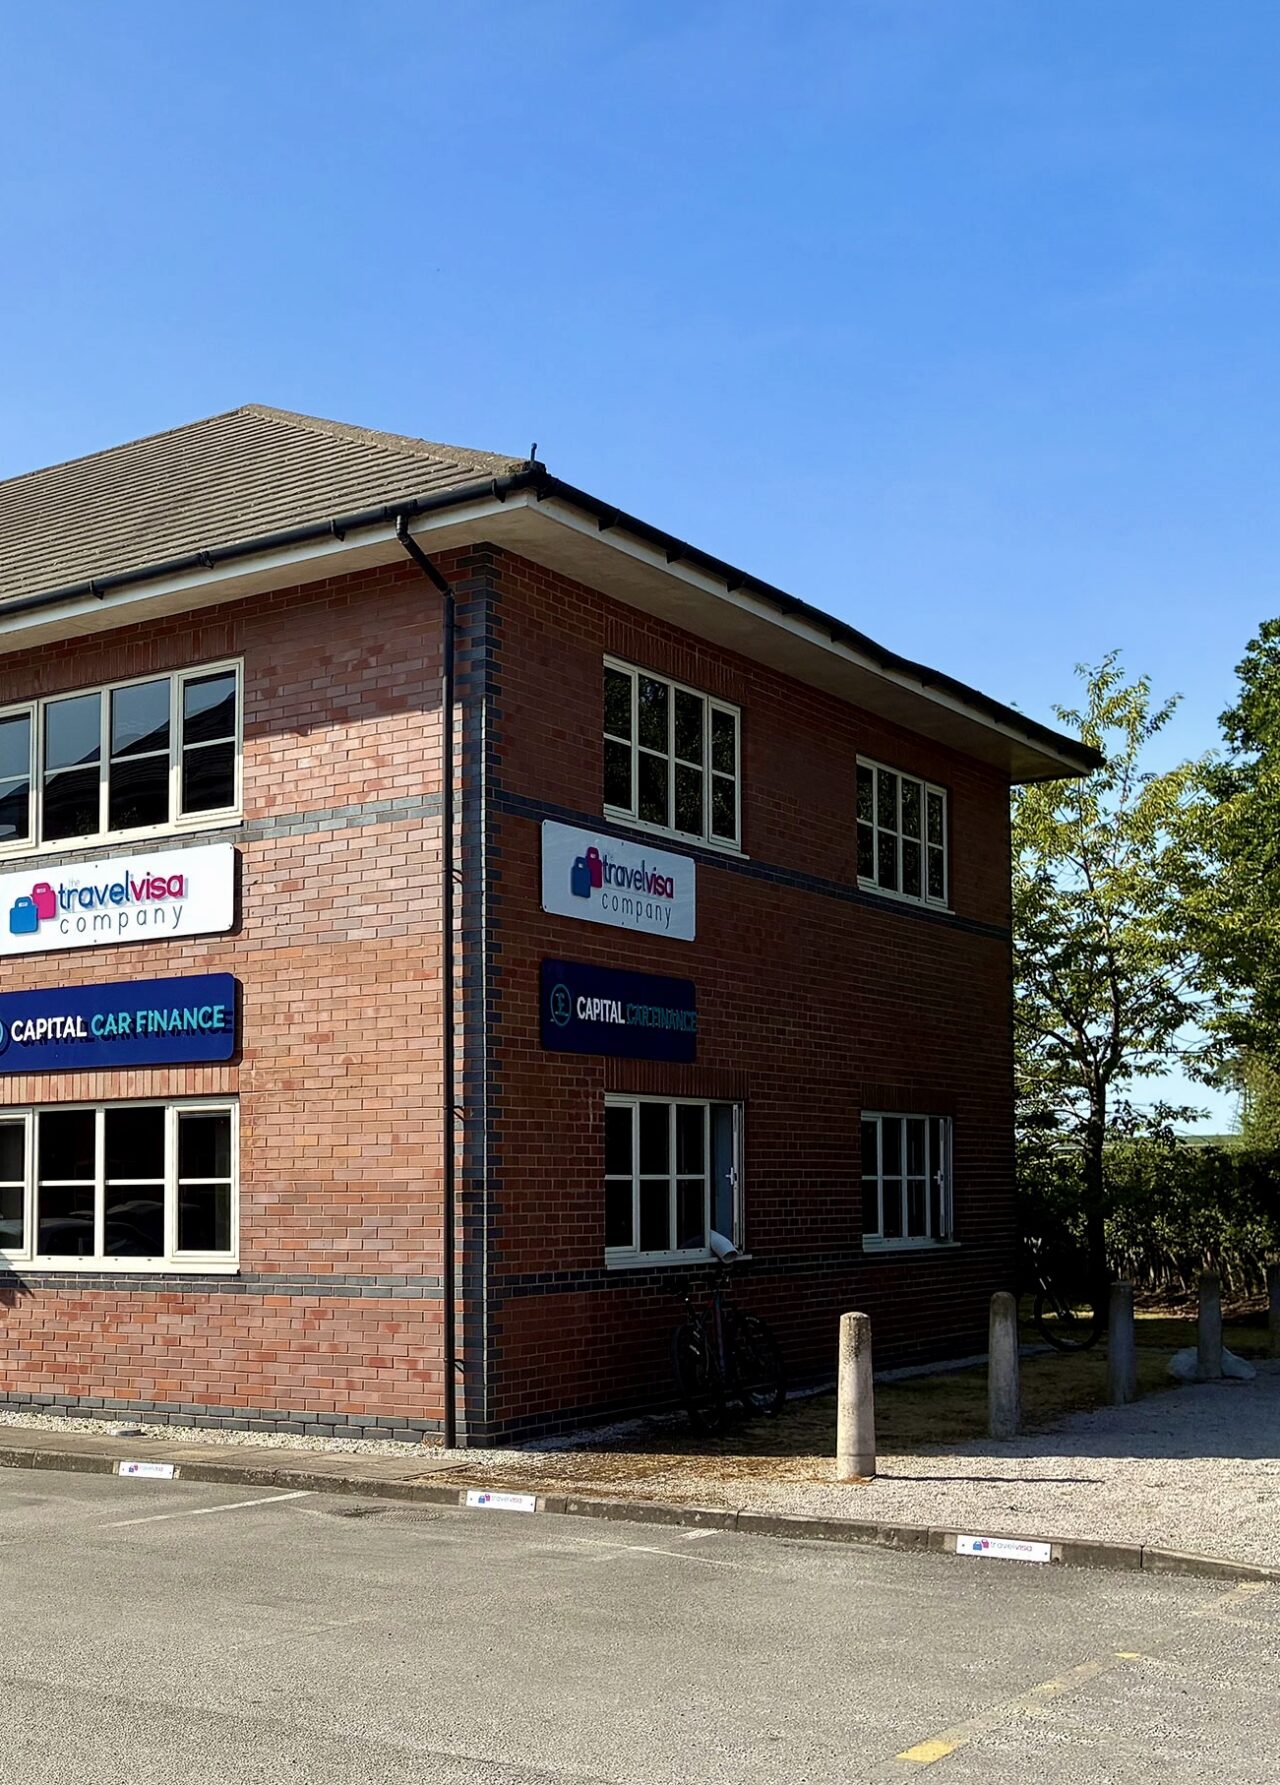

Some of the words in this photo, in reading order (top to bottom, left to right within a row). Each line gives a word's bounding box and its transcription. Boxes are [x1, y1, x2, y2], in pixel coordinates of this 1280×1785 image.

[58, 870, 185, 910] travelvisa
[602, 854, 674, 899] travelvisa
[60, 905, 183, 935] company
[601, 892, 672, 929] company
[11, 1015, 88, 1042] CAPITAL
[91, 1012, 130, 1036] CAR
[137, 1005, 225, 1033] FINANCE
[576, 996, 626, 1025] CAPITAL
